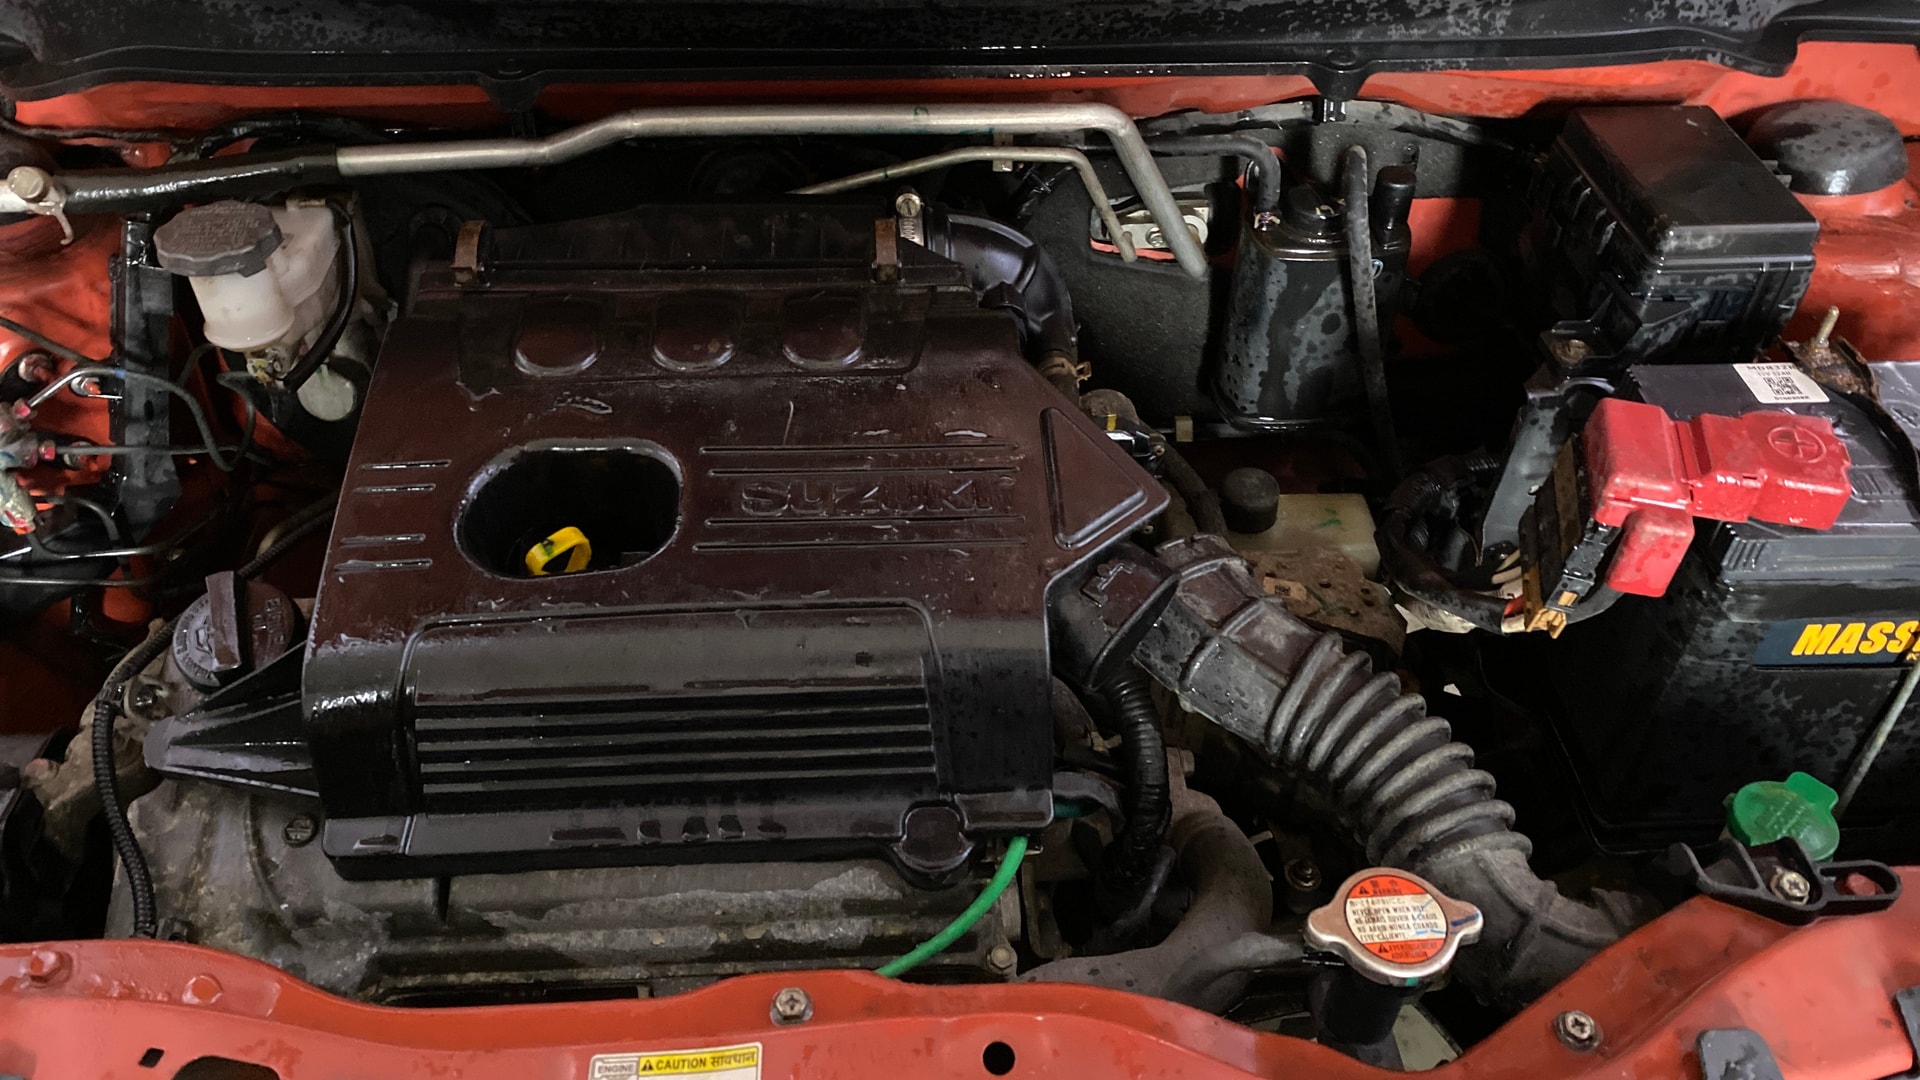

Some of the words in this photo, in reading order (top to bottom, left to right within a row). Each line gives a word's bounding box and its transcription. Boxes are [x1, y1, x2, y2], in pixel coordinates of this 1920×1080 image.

[741, 480, 993, 516] SUZUKI
[1791, 621, 1920, 656] MASS
[1392, 905, 1410, 914] WHEN
[656, 1057, 707, 1071] CAUTION
[711, 1051, 756, 1067] सावधान
[597, 1063, 636, 1074] ENGINE
